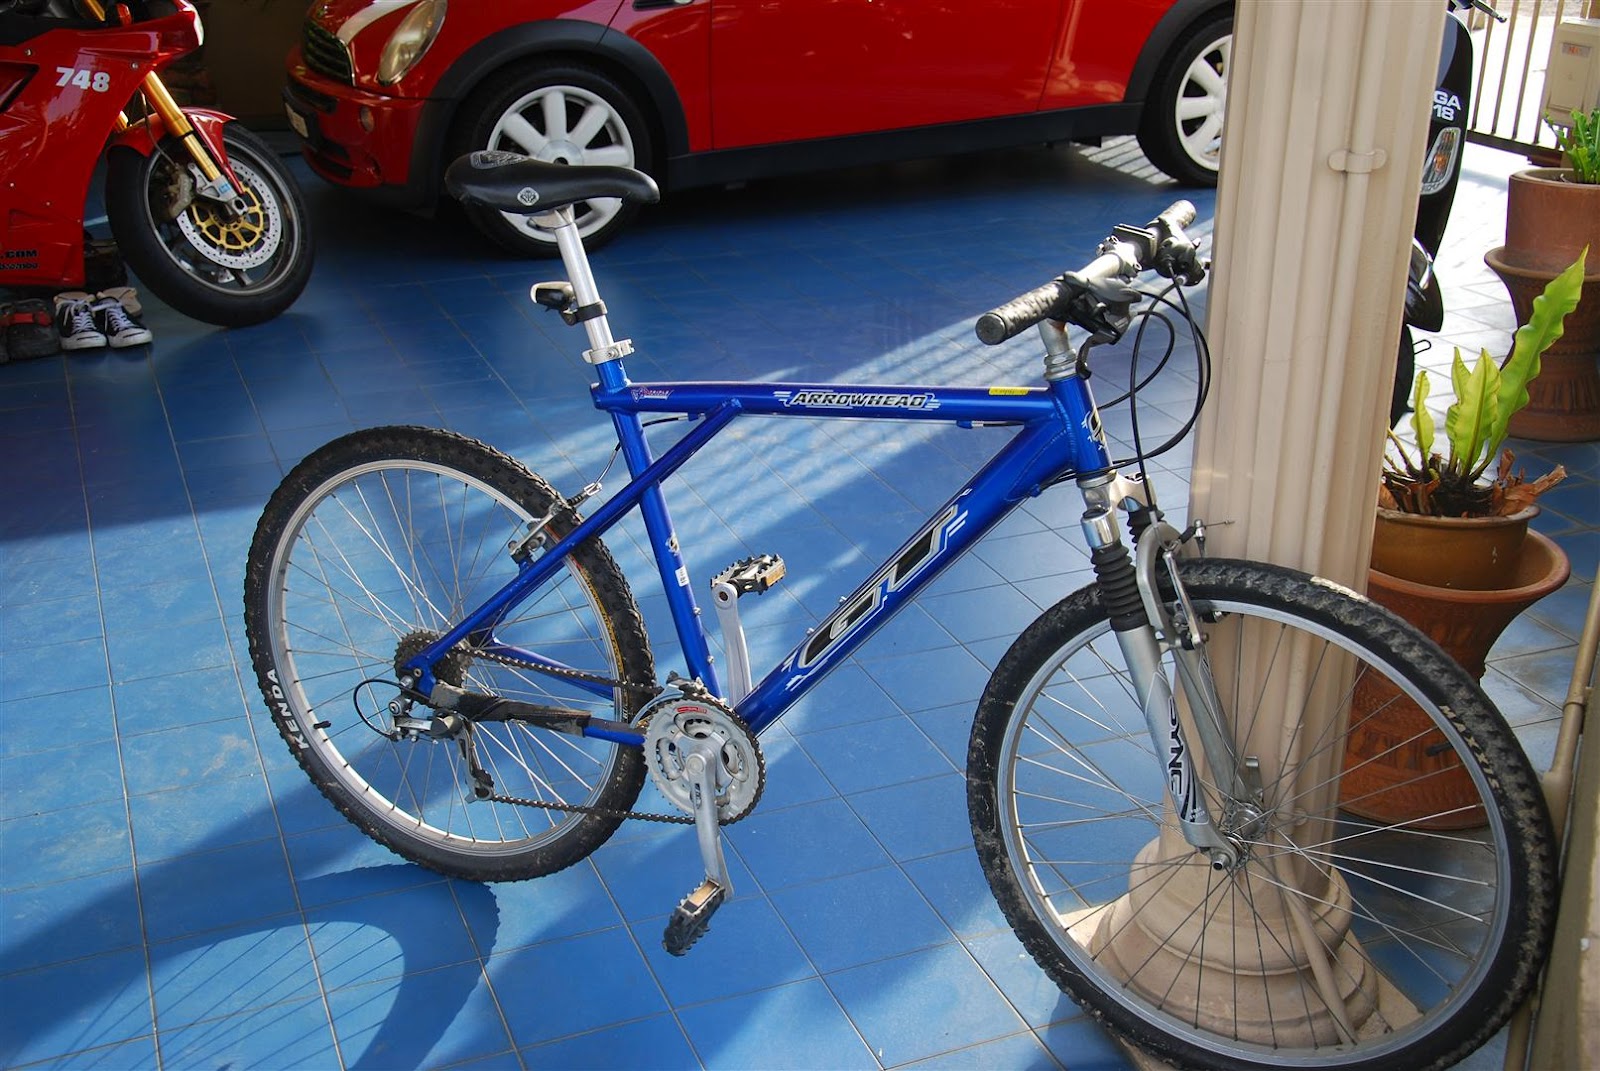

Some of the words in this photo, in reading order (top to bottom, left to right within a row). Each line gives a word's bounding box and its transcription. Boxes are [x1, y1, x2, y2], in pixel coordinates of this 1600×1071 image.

[55, 66, 110, 93] 748
[1433, 104, 1454, 121] 18
[791, 391, 927, 409] ARROWHEAD
[797, 503, 959, 669] GT
[266, 668, 311, 749] KENDA
[1438, 704, 1500, 788] MAXXIS
